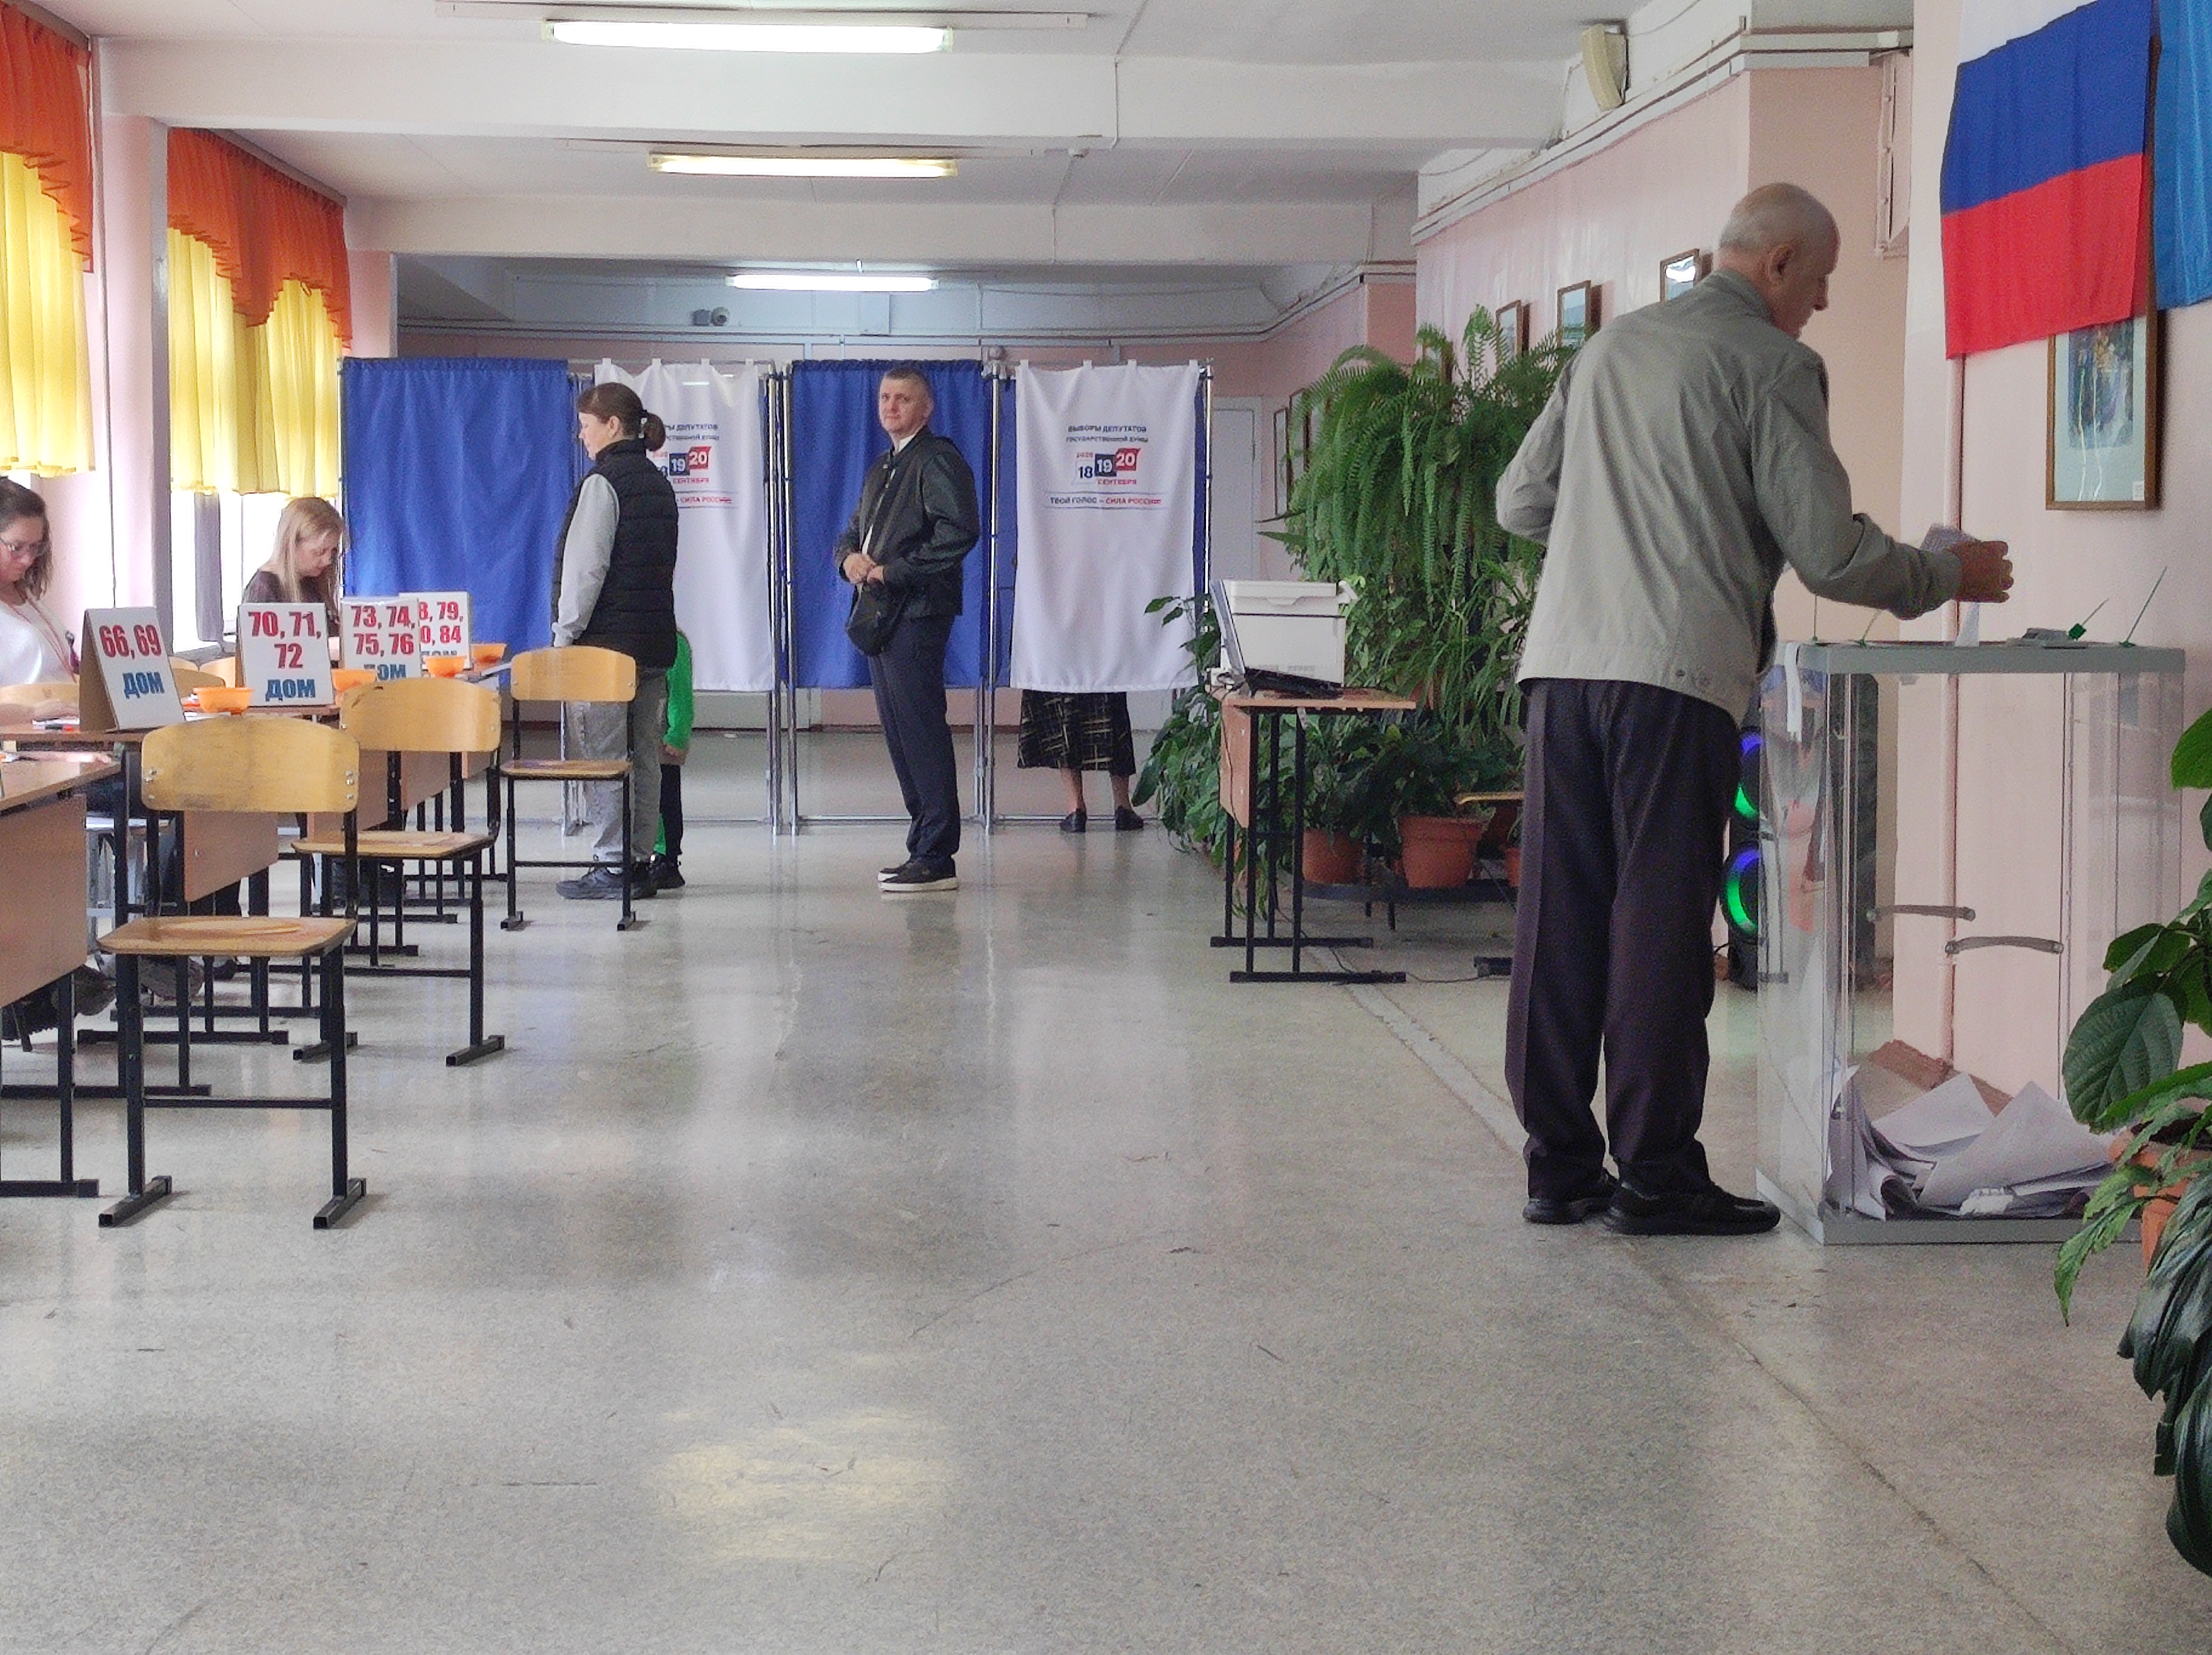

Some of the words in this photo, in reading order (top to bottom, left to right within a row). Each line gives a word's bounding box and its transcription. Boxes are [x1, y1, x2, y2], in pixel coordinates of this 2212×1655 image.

[671, 458, 686, 472] 19
[689, 451, 707, 465] 20
[1078, 466, 1093, 479] 18
[1097, 459, 1112, 472] 19
[1116, 452, 1135, 466] 20
[350, 605, 382, 630] 73,
[386, 605, 415, 631] 74,
[420, 601, 433, 623] 8,
[437, 601, 463, 623] 79,
[247, 611, 285, 640] 70,
[288, 611, 321, 640] 71,
[420, 625, 435, 646] 0,
[440, 625, 461, 644] 84
[133, 624, 162, 657] 69
[353, 633, 385, 657] 75,
[389, 633, 414, 655] 76
[274, 643, 303, 669] 72
[122, 671, 165, 700] ДОМ
[265, 678, 316, 702] ДОМ
